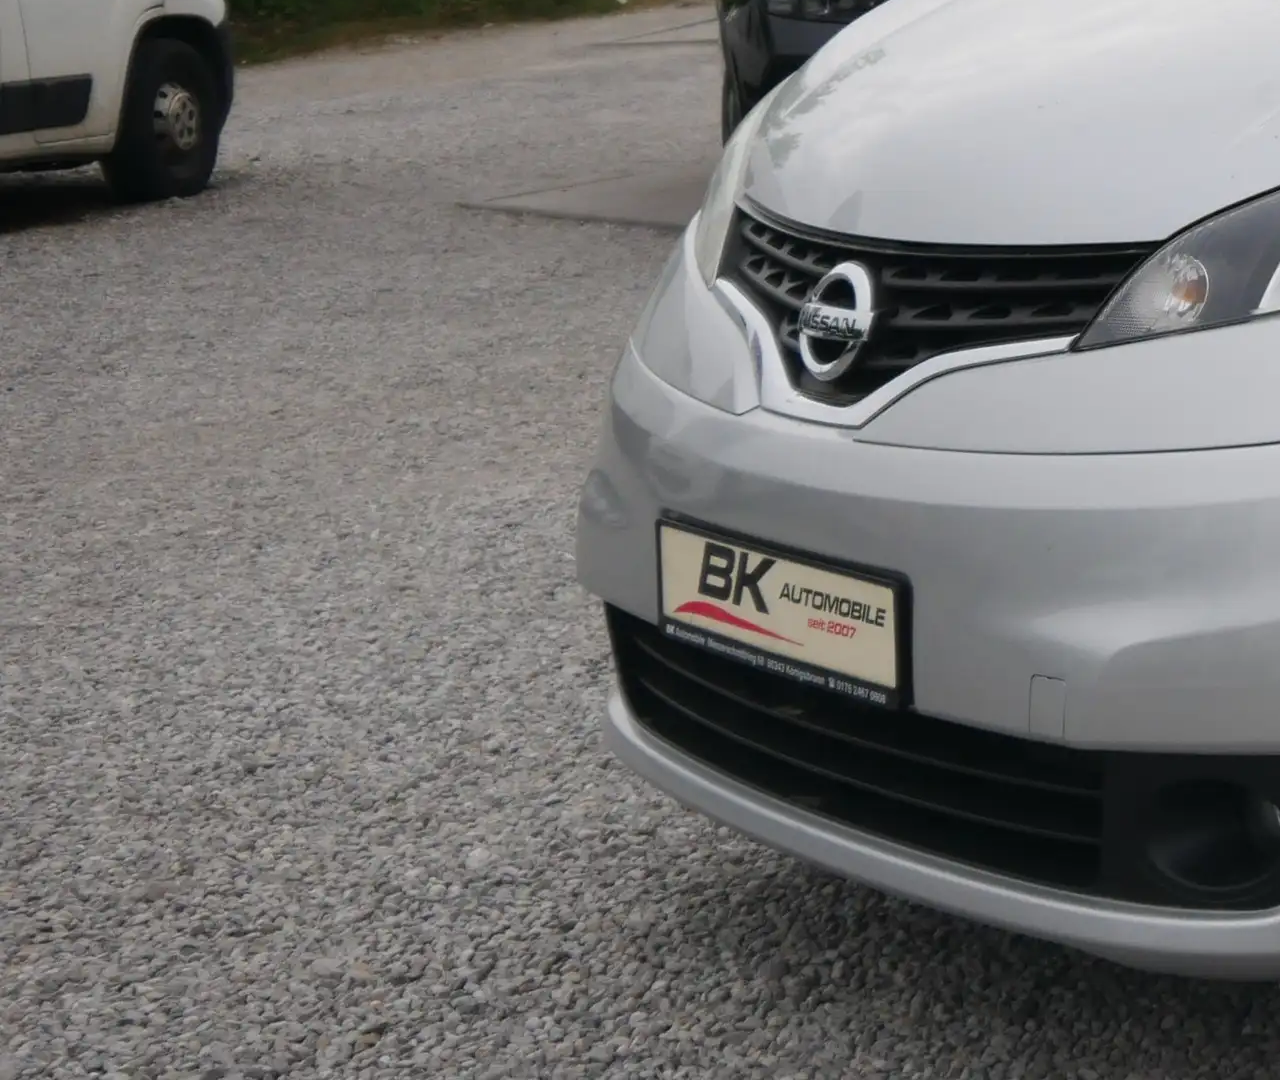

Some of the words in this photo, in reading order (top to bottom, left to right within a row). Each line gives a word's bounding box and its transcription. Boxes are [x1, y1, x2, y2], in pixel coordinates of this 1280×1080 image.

[697, 541, 777, 615] BK
[779, 582, 887, 628] AUTOMOBILE
[807, 618, 826, 631] seit
[827, 620, 857, 639] 2007
